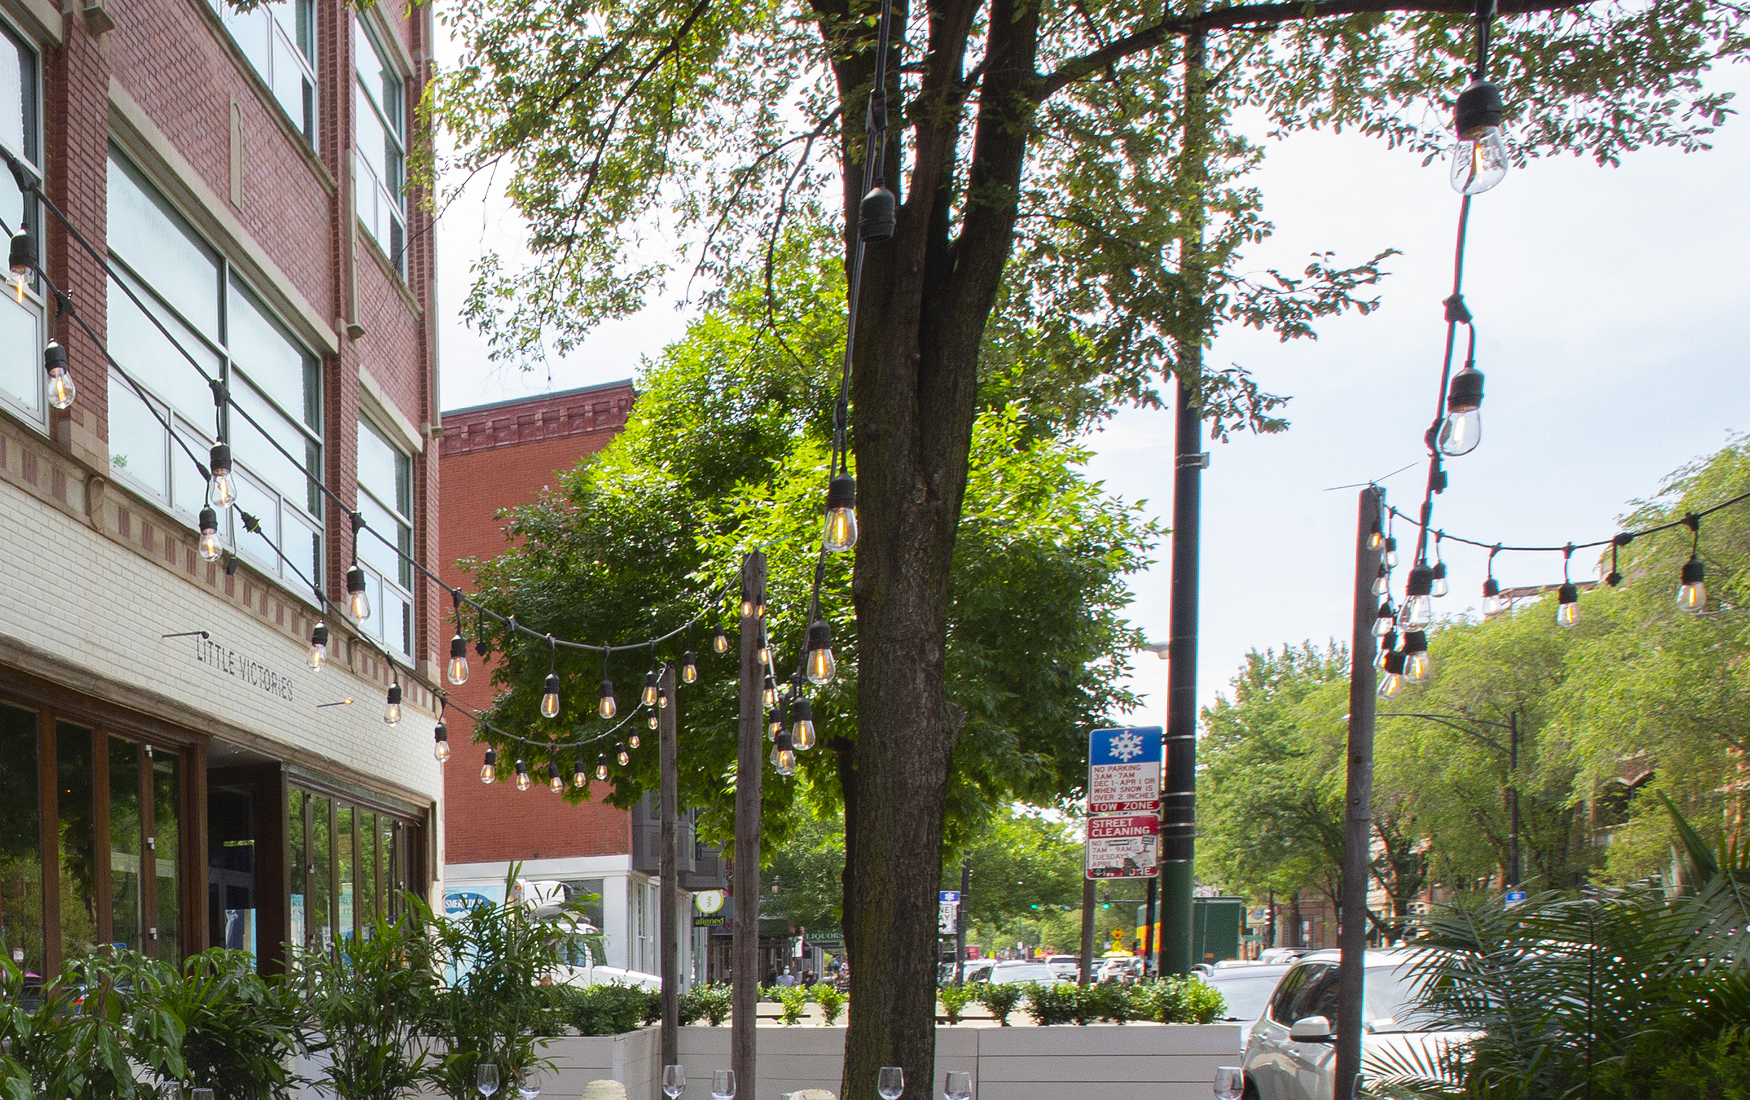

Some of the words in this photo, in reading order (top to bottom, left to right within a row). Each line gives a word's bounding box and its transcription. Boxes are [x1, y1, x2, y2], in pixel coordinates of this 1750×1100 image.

[197, 634, 235, 676] LITTLE
[239, 656, 293, 702] VICTORIES
[1093, 803, 1118, 811] TOW
[1123, 801, 1154, 810] ZONE
[1092, 818, 1133, 828] STREET
[1091, 826, 1150, 837] CLEANING
[695, 917, 724, 927] aligned
[806, 932, 844, 940] LIQUORS
